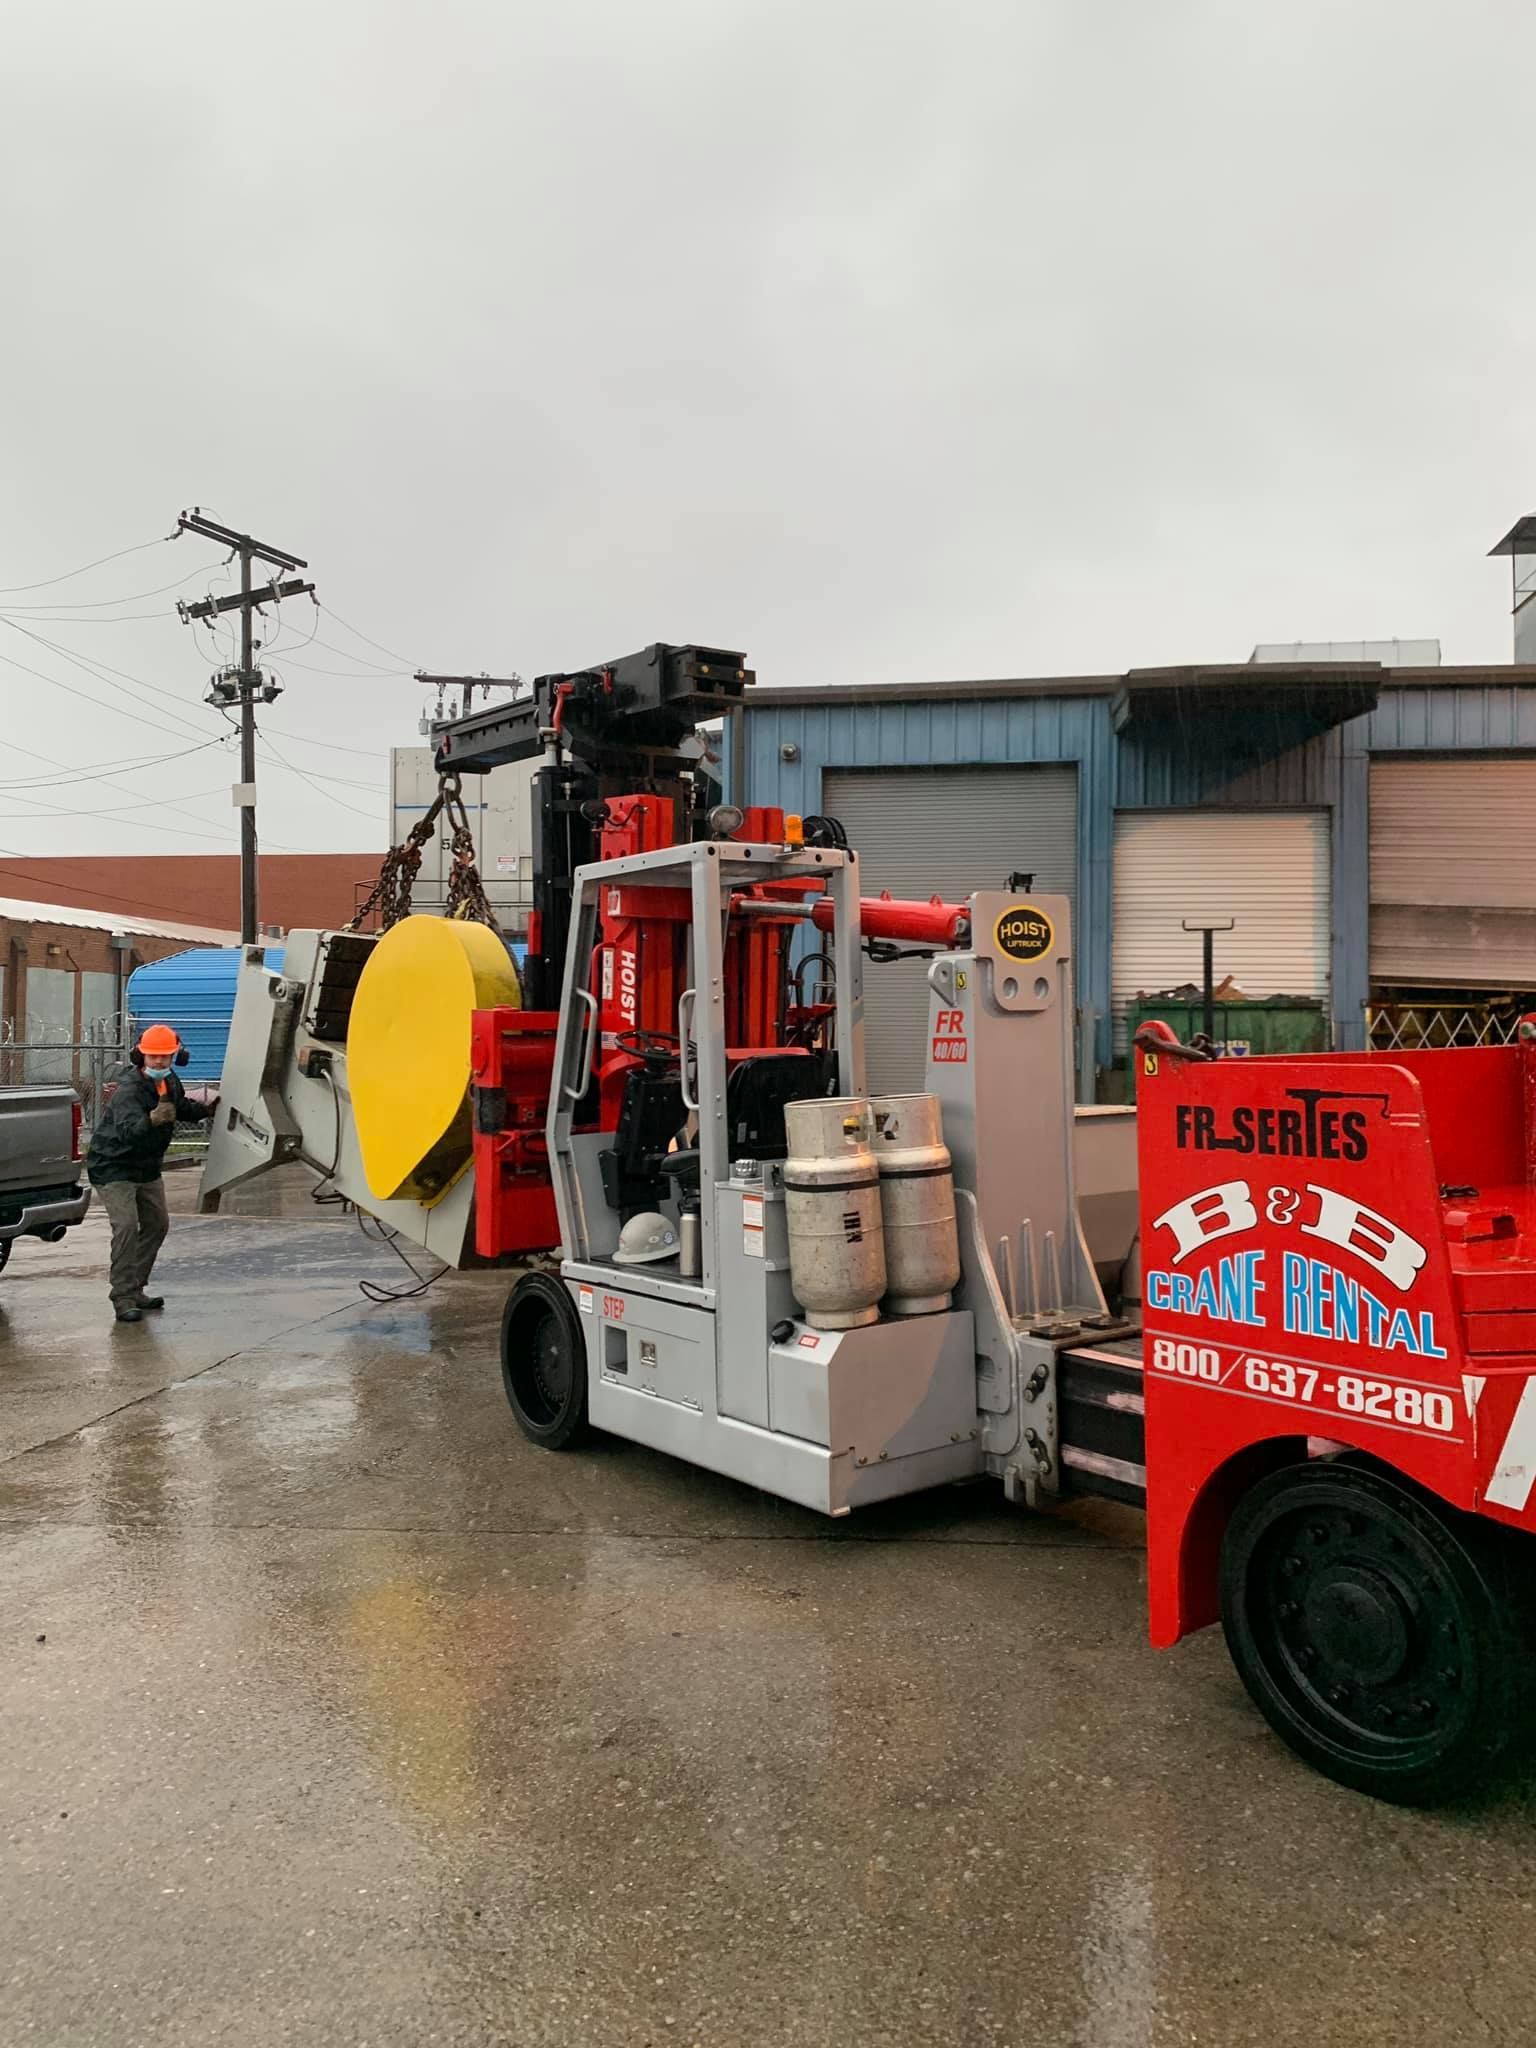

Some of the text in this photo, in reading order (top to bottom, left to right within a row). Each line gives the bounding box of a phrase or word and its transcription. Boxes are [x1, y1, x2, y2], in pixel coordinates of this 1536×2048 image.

[1000, 921, 1048, 939] HOIST
[1007, 940, 1042, 948] LIFTRUCK
[620, 950, 636, 1026] HOIST
[936, 1010, 964, 1033] FR
[1152, 1179, 1428, 1292] B & B
[603, 1295, 624, 1321] STEP
[1147, 1249, 1448, 1360] CRANE RENTAL
[1153, 1338, 1455, 1432] 800/637-8280
